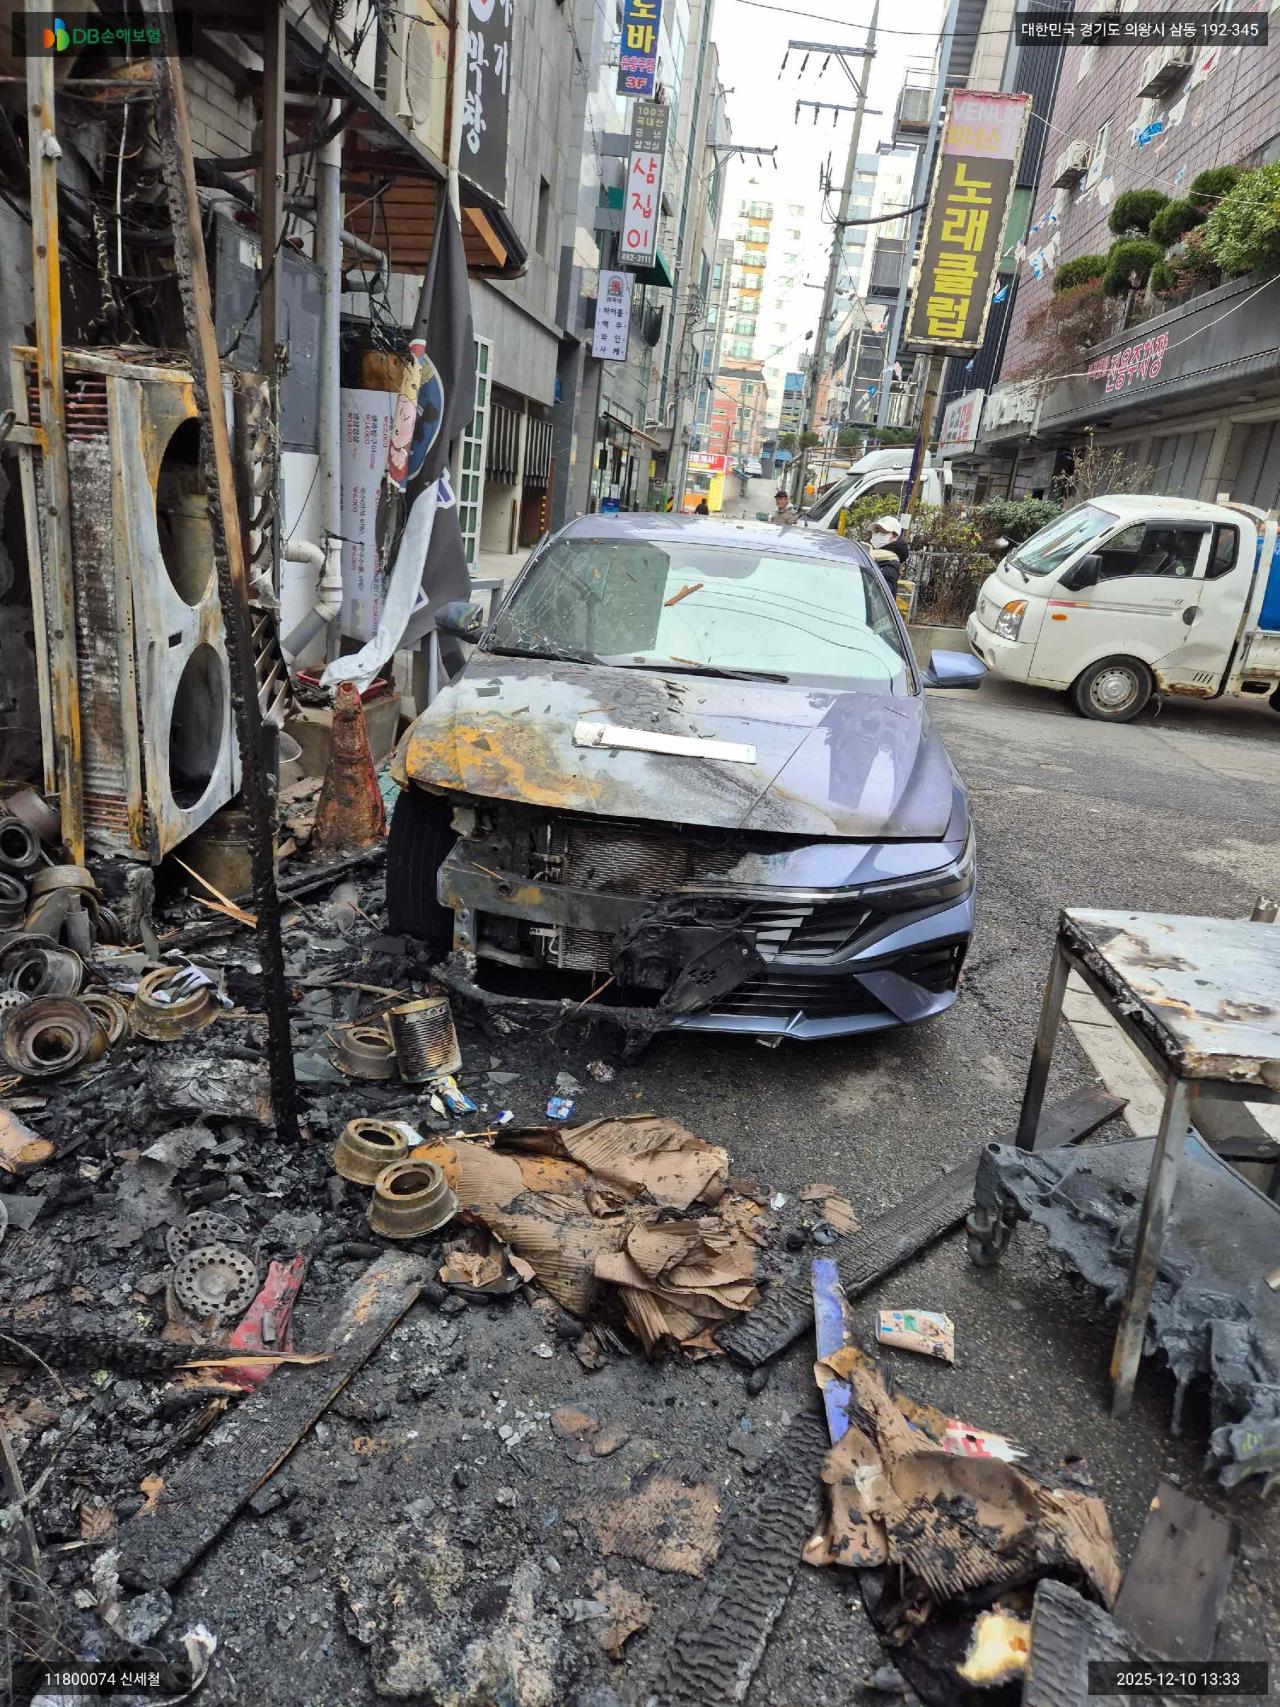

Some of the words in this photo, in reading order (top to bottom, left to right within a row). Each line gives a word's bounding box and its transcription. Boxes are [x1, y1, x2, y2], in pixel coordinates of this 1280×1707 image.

[620, 55, 656, 74] 유흥주점
[625, 76, 648, 89] 3F
[636, 116, 665, 128] 국내산
[926, 162, 992, 338] 노래클럽
[603, 307, 624, 317] 하이볼
